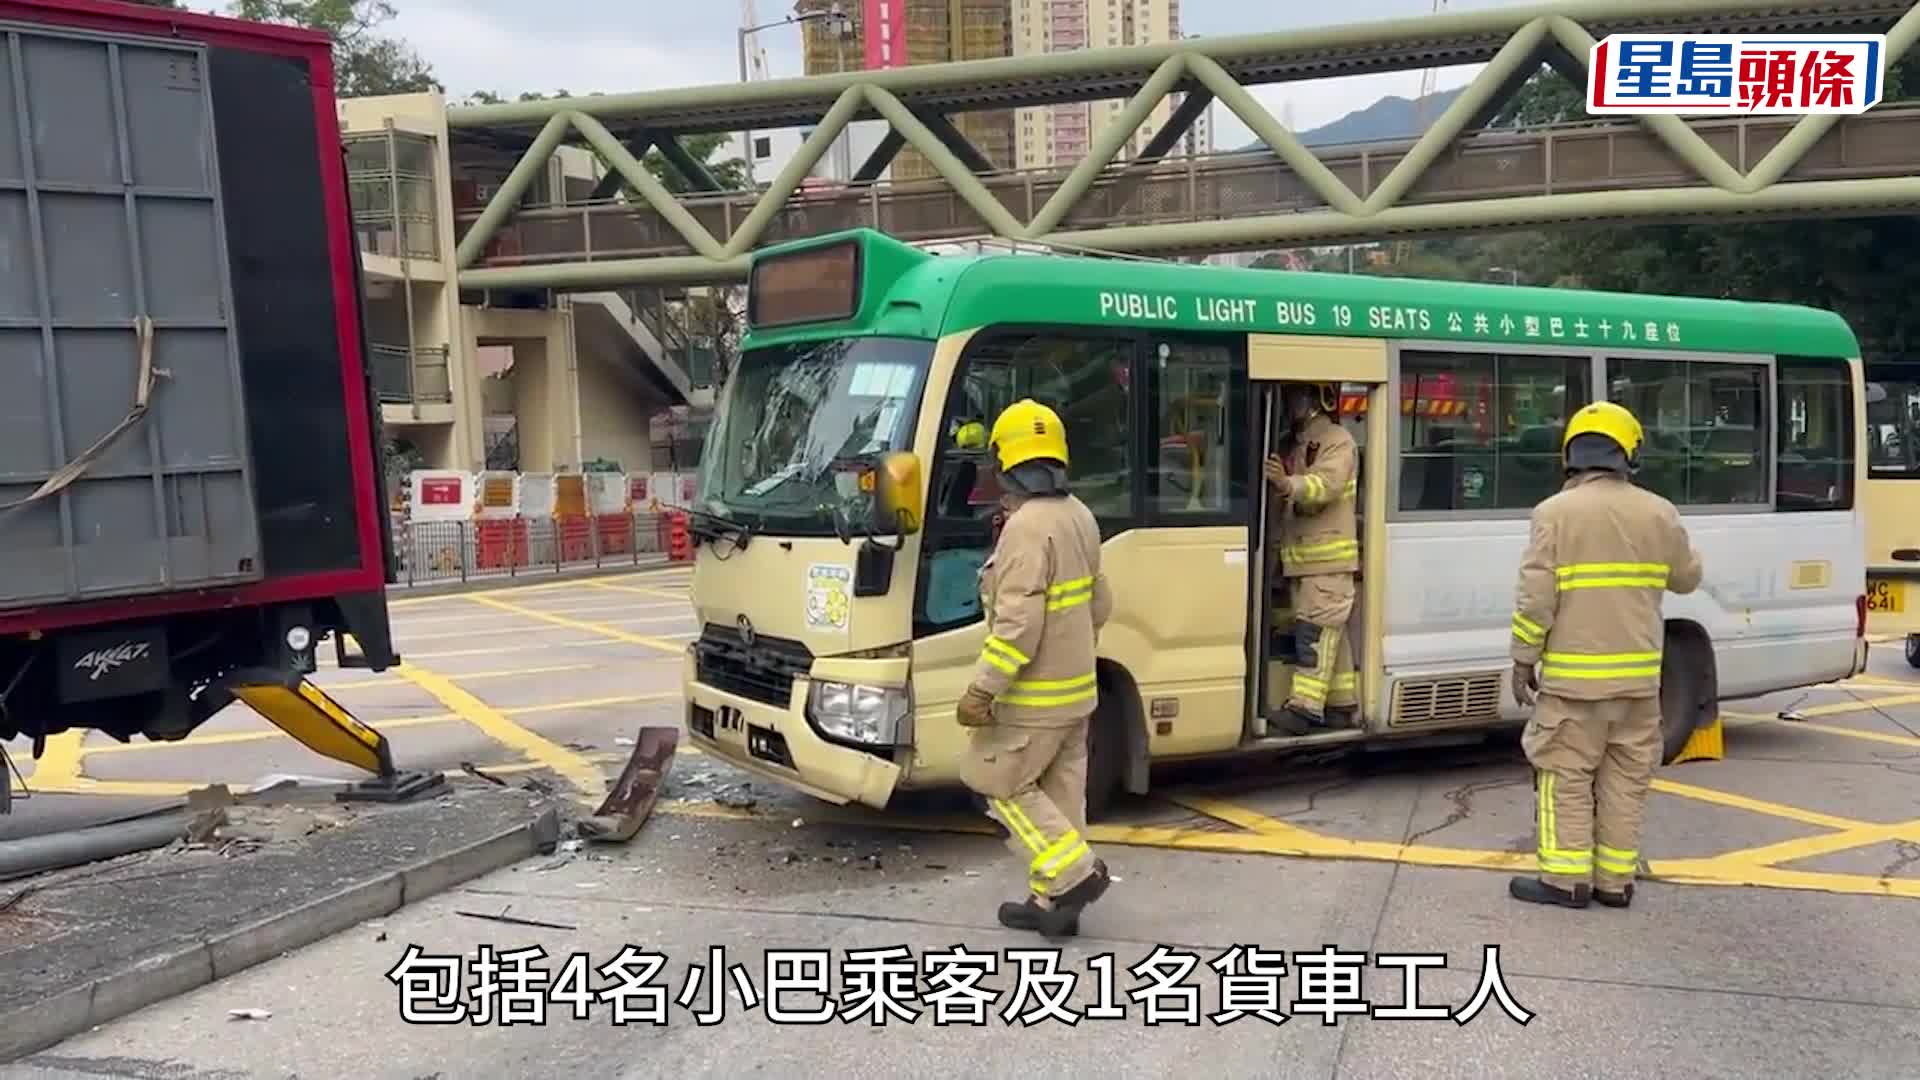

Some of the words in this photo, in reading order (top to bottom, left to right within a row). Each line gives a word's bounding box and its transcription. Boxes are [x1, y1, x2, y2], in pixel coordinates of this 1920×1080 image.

[1099, 292, 1177, 319] PUBLIC
[1196, 297, 1257, 323] LIGHT
[1277, 301, 1315, 326] BUS
[1332, 305, 1352, 327] 19
[1369, 307, 1431, 331] SEATS
[1447, 311, 1681, 343] 公共小型巴士十九座位
